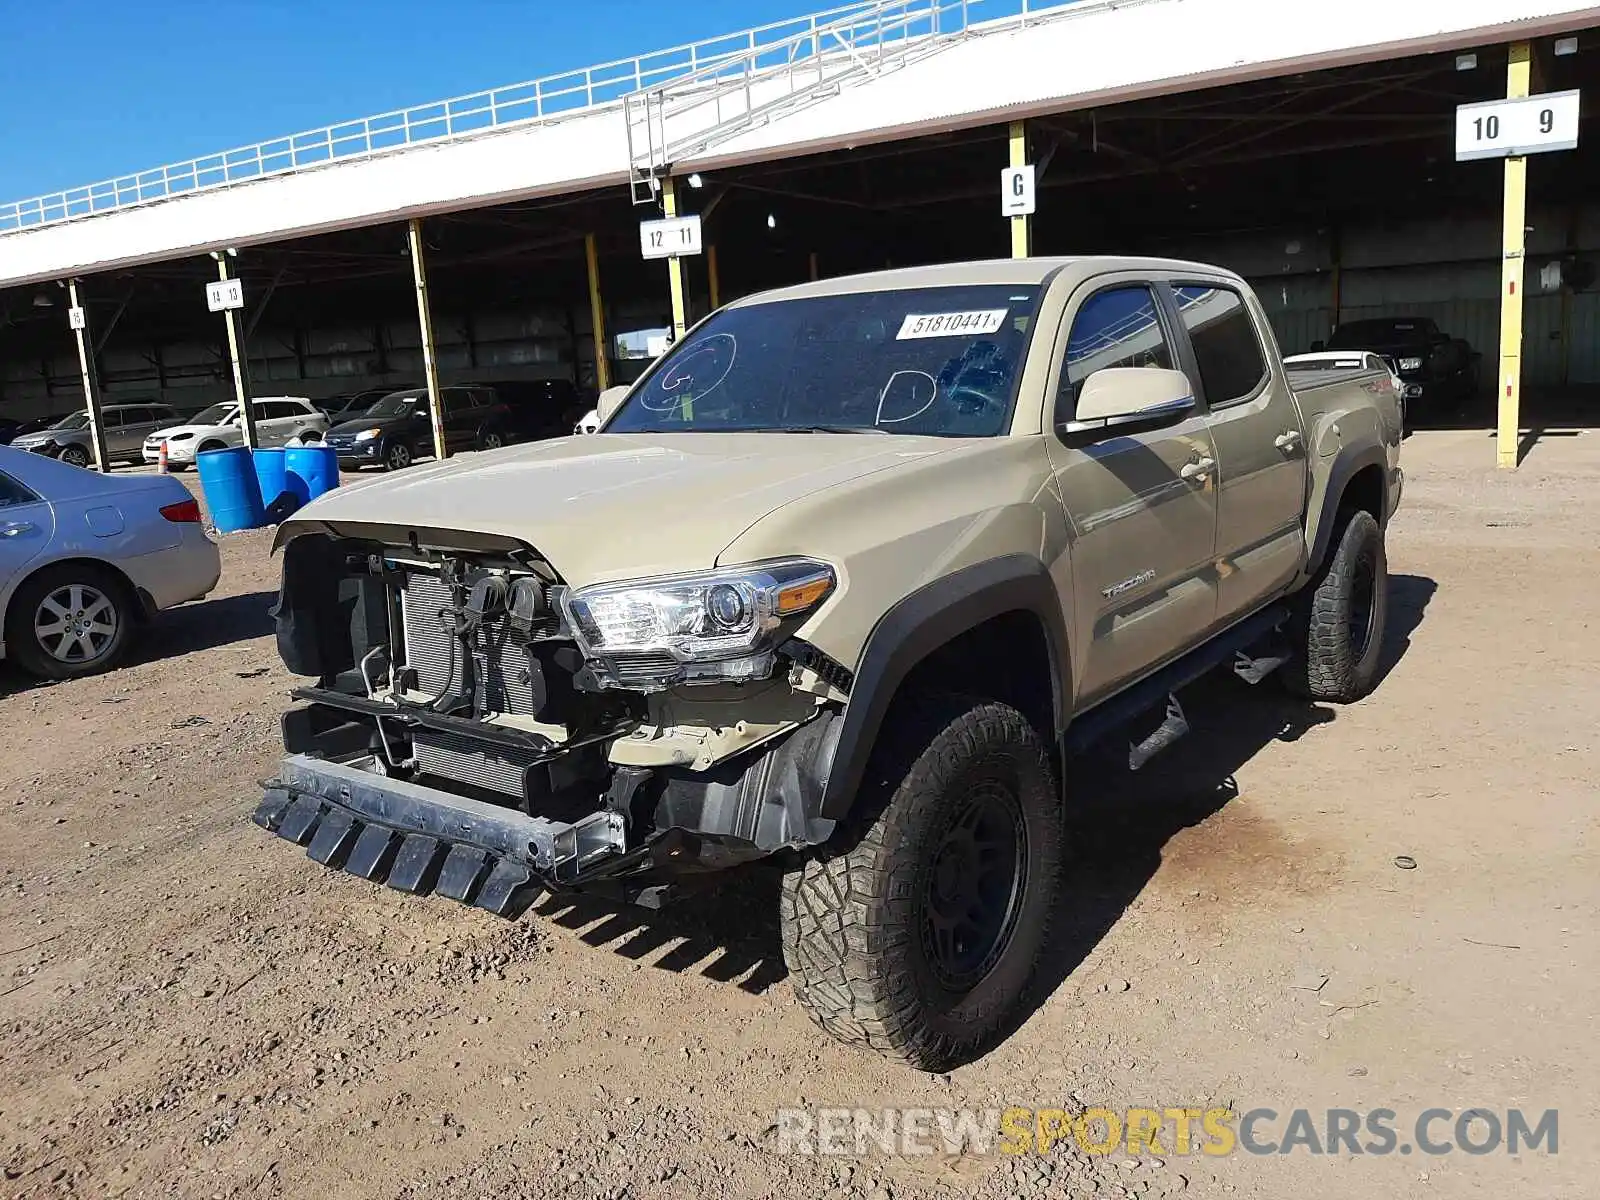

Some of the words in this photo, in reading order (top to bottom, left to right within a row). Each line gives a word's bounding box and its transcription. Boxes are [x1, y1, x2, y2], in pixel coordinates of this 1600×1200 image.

[1473, 115, 1499, 140] 10
[1539, 109, 1553, 133] 9
[1013, 174, 1023, 196] G
[650, 230, 663, 248] 12
[680, 228, 691, 244] 11
[213, 290, 221, 303] 14
[229, 288, 238, 301] 13
[913, 312, 992, 334] 51810441
